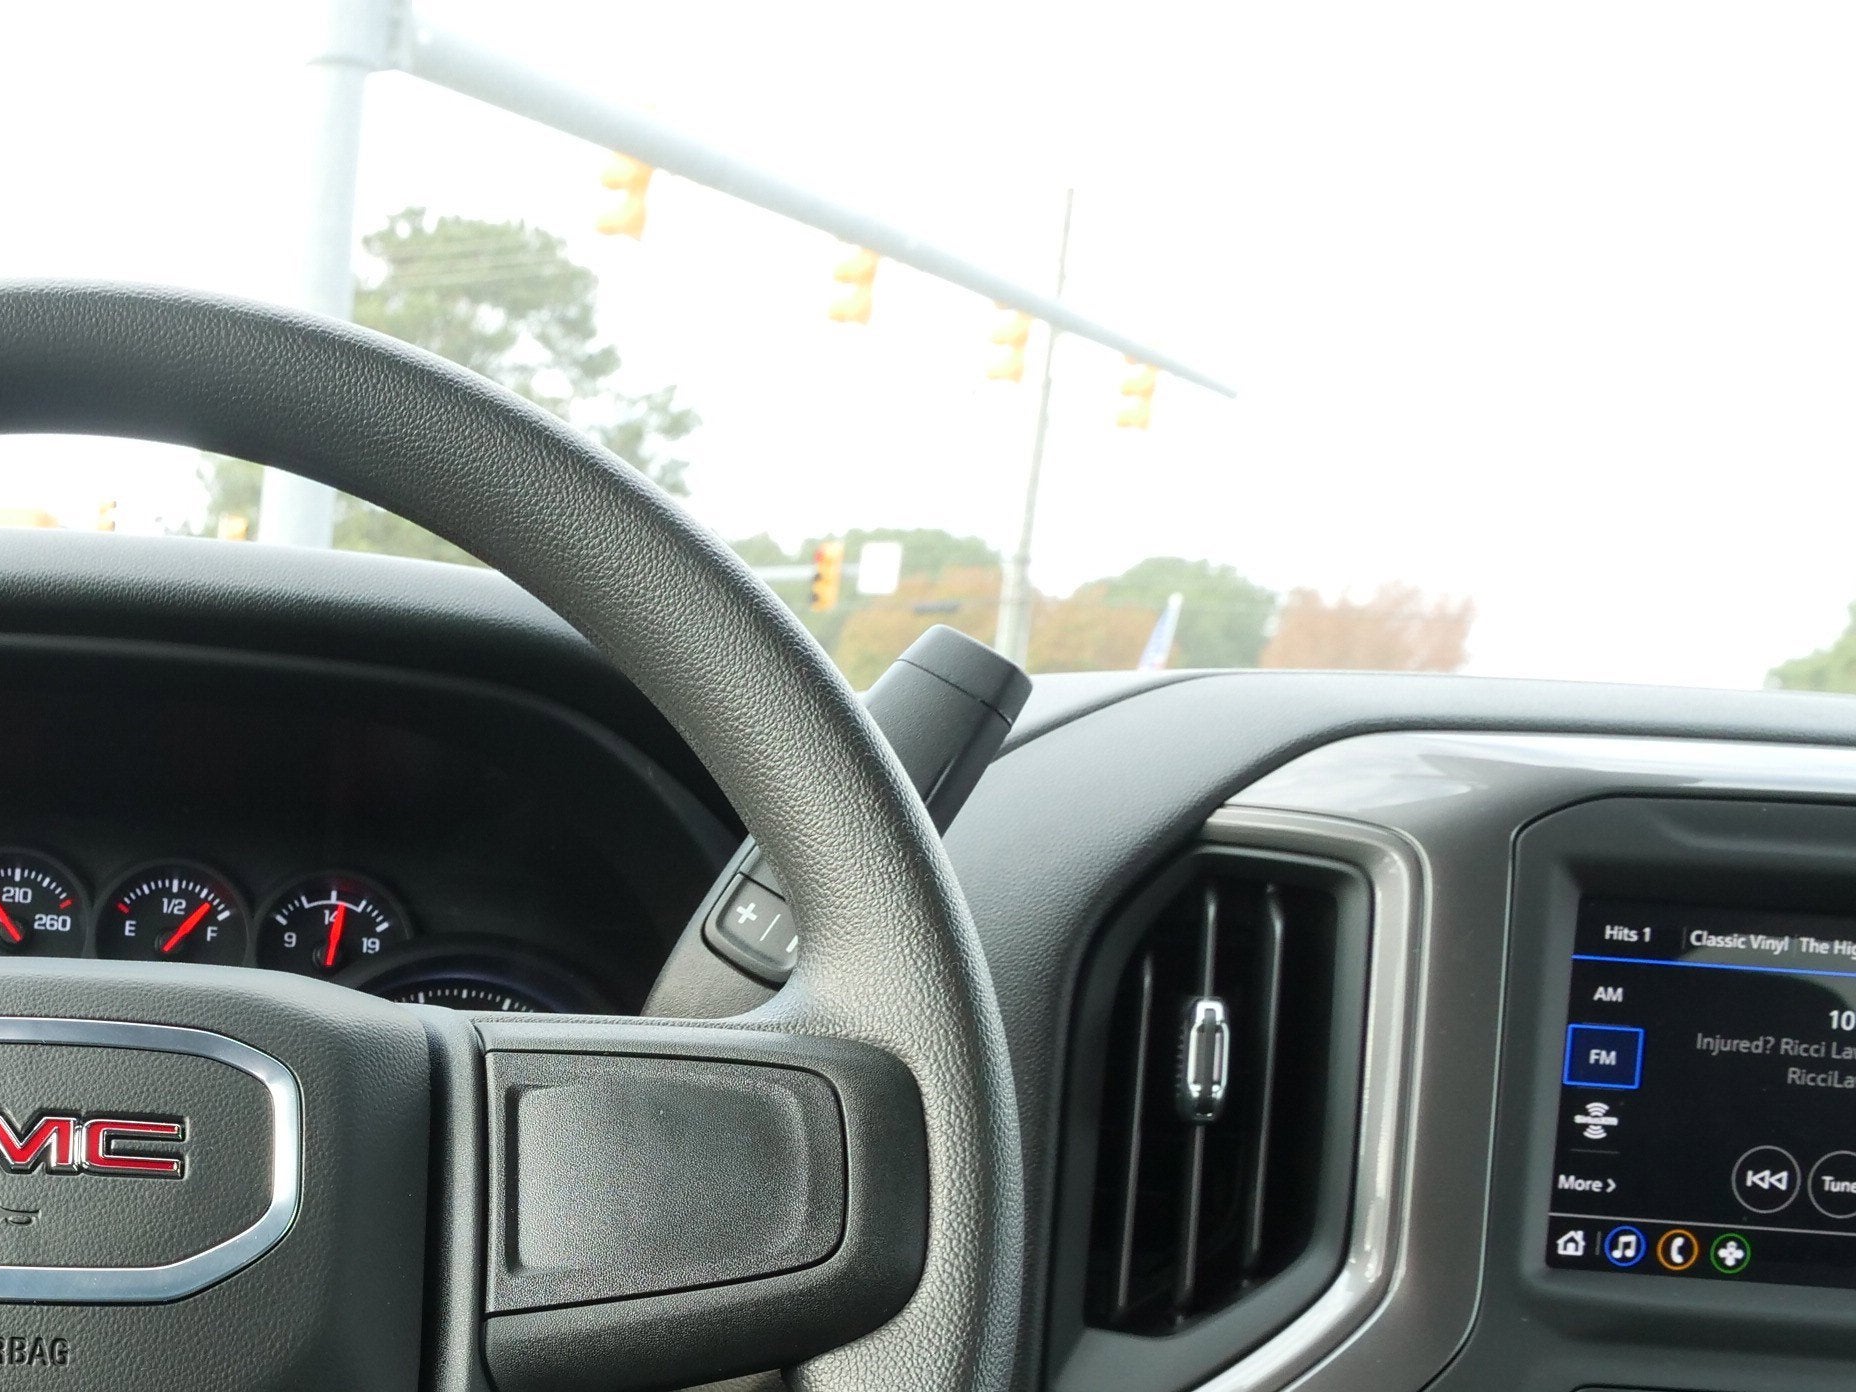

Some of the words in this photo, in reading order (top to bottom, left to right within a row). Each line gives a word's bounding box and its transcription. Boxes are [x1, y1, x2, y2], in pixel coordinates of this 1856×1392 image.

[1, 886, 33, 904] 210
[162, 897, 186, 915] 1/2
[33, 913, 71, 932] 260
[124, 920, 136, 937] E
[206, 926, 218, 942] F
[283, 931, 297, 948] 9
[1604, 924, 1638, 942] Hits
[1642, 926, 1652, 942] 1
[1689, 929, 1746, 950] Classic
[1749, 934, 1790, 955] Vinyl
[362, 937, 380, 954] 19
[1799, 936, 1829, 955] The
[1593, 985, 1624, 1003] AM
[1829, 1009, 1856, 1031] 10
[1696, 1033, 1776, 1057] Injured?
[1779, 1037, 1826, 1058] Ricci
[1830, 1041, 1856, 1060] La
[1589, 1048, 1617, 1066] FM
[1786, 1066, 1856, 1089] RicciLa
[1558, 1174, 1603, 1193] More
